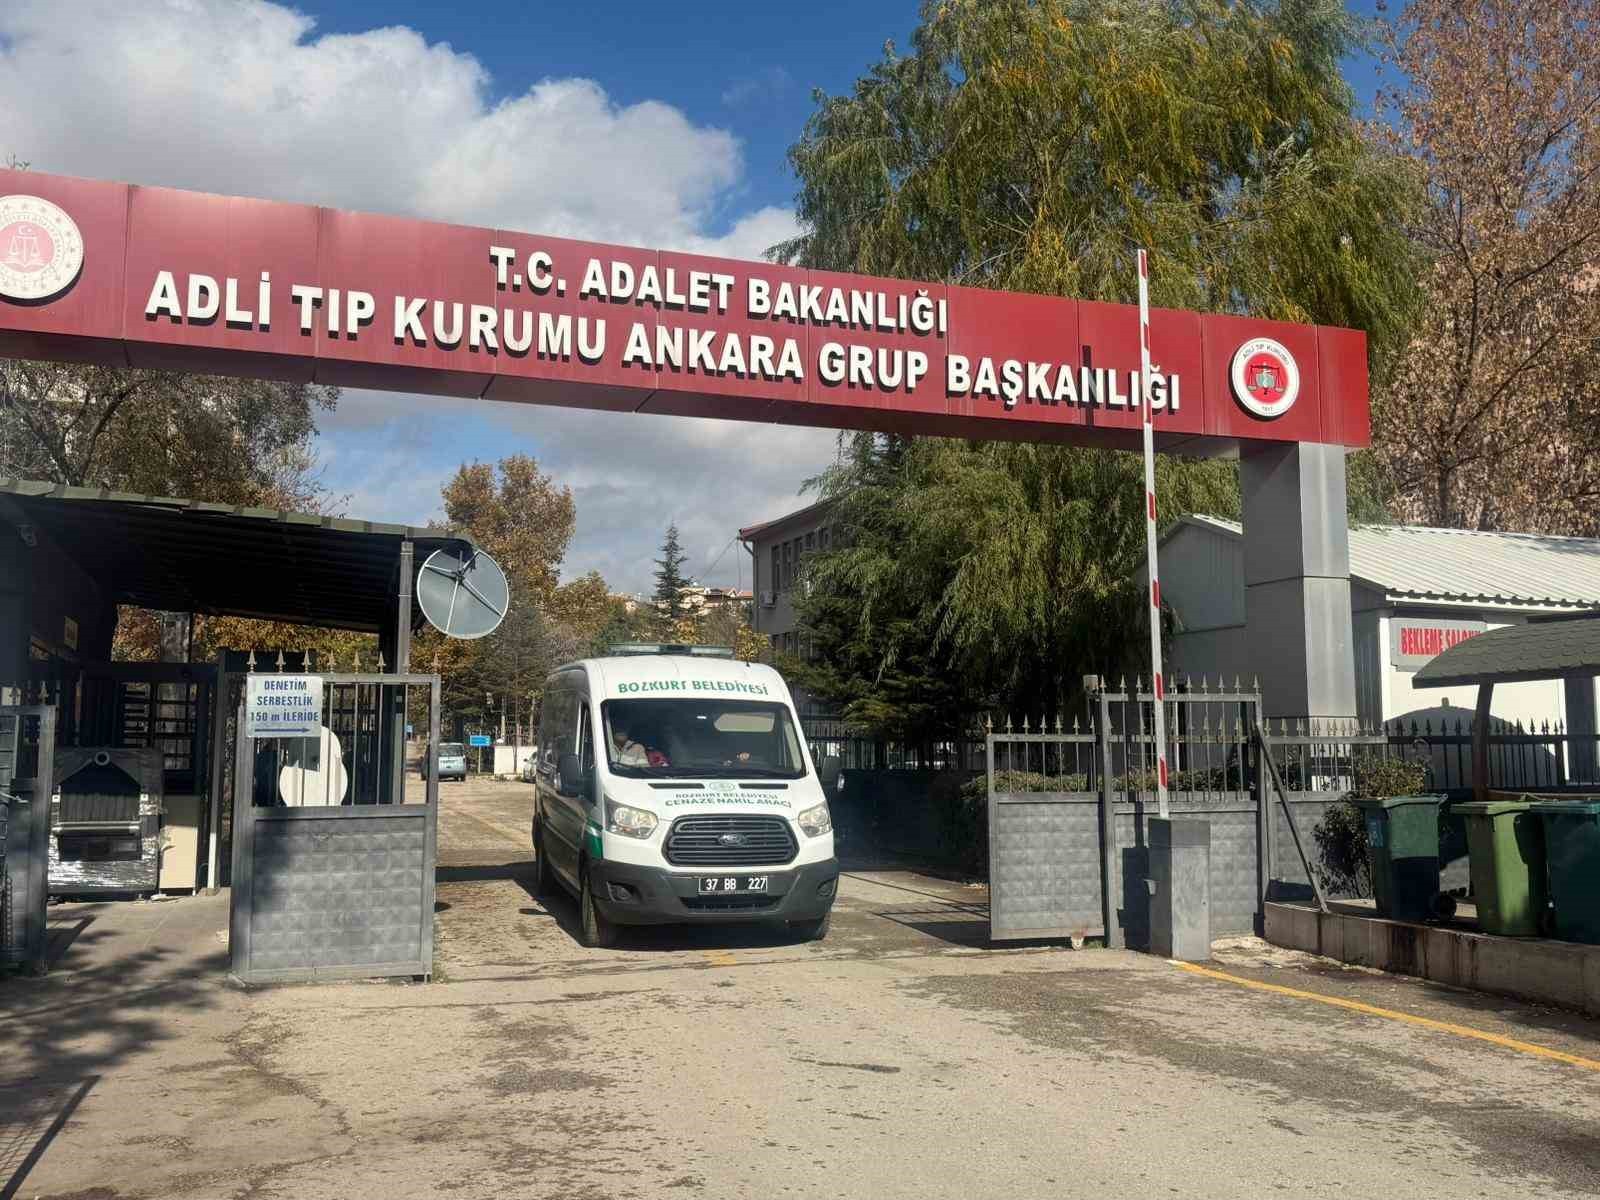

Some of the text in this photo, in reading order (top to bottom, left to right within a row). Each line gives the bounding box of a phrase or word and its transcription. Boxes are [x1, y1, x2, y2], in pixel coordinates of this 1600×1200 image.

[490, 246, 947, 333] T.C. ADALET BAKANLIĞI
[145, 270, 1181, 412] ADLİ TIP KURUMU ANKARA GRUP BAŞKANLIĞI
[1400, 627, 1442, 655] BEKLEME
[264, 678, 307, 691] DENETİM
[618, 679, 769, 696] BOZKURT BELEDİYESİ
[256, 692, 313, 706] SERBESTLİK
[250, 708, 319, 722] 150 m İLERİDE
[665, 798, 714, 807] CENAZE
[705, 877, 766, 891] 37 BB 227
